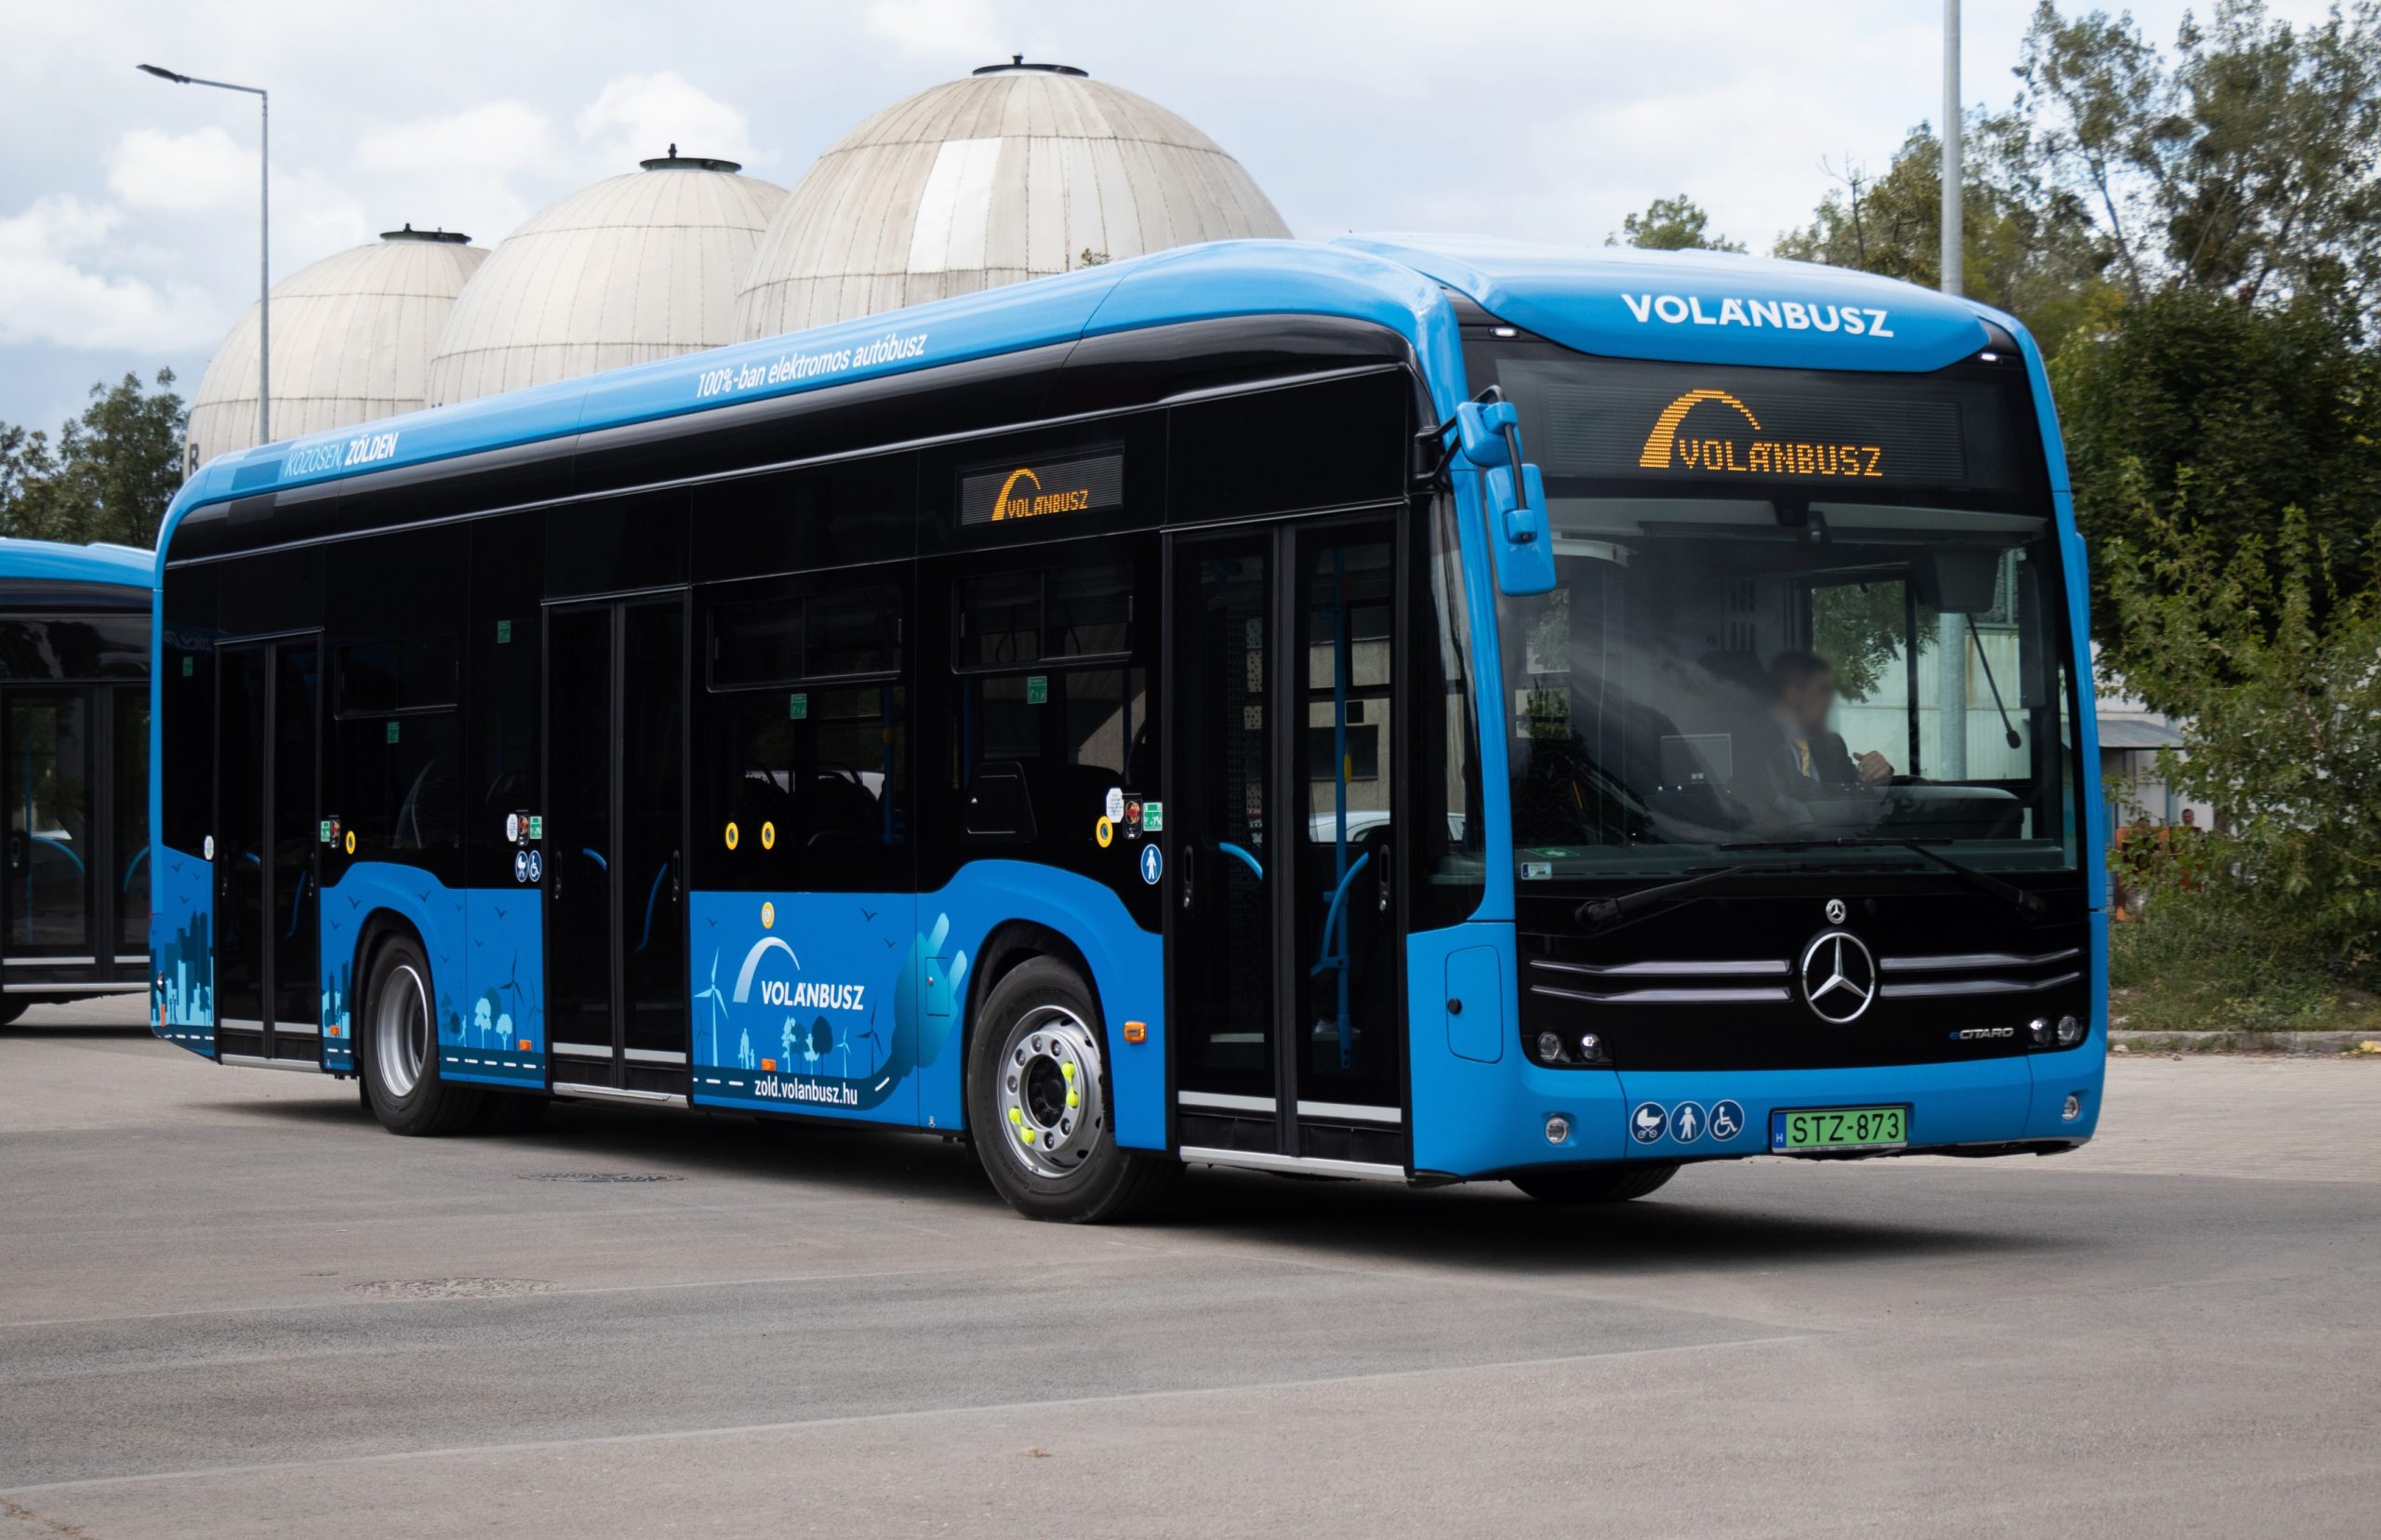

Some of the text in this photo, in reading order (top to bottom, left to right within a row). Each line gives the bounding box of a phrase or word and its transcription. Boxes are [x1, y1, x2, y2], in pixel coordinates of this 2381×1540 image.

[1621, 294, 1894, 338] VOLÁNBUSZ
[697, 334, 928, 398] 100%-ban elektromos autóbusz
[345, 432, 400, 466] ZÖLDEN
[762, 980, 864, 1010] VOLÁNBUSZ
[754, 1075, 858, 1106] zold.volanbusz.hu
[1792, 1112, 1899, 1144] STZ-873
